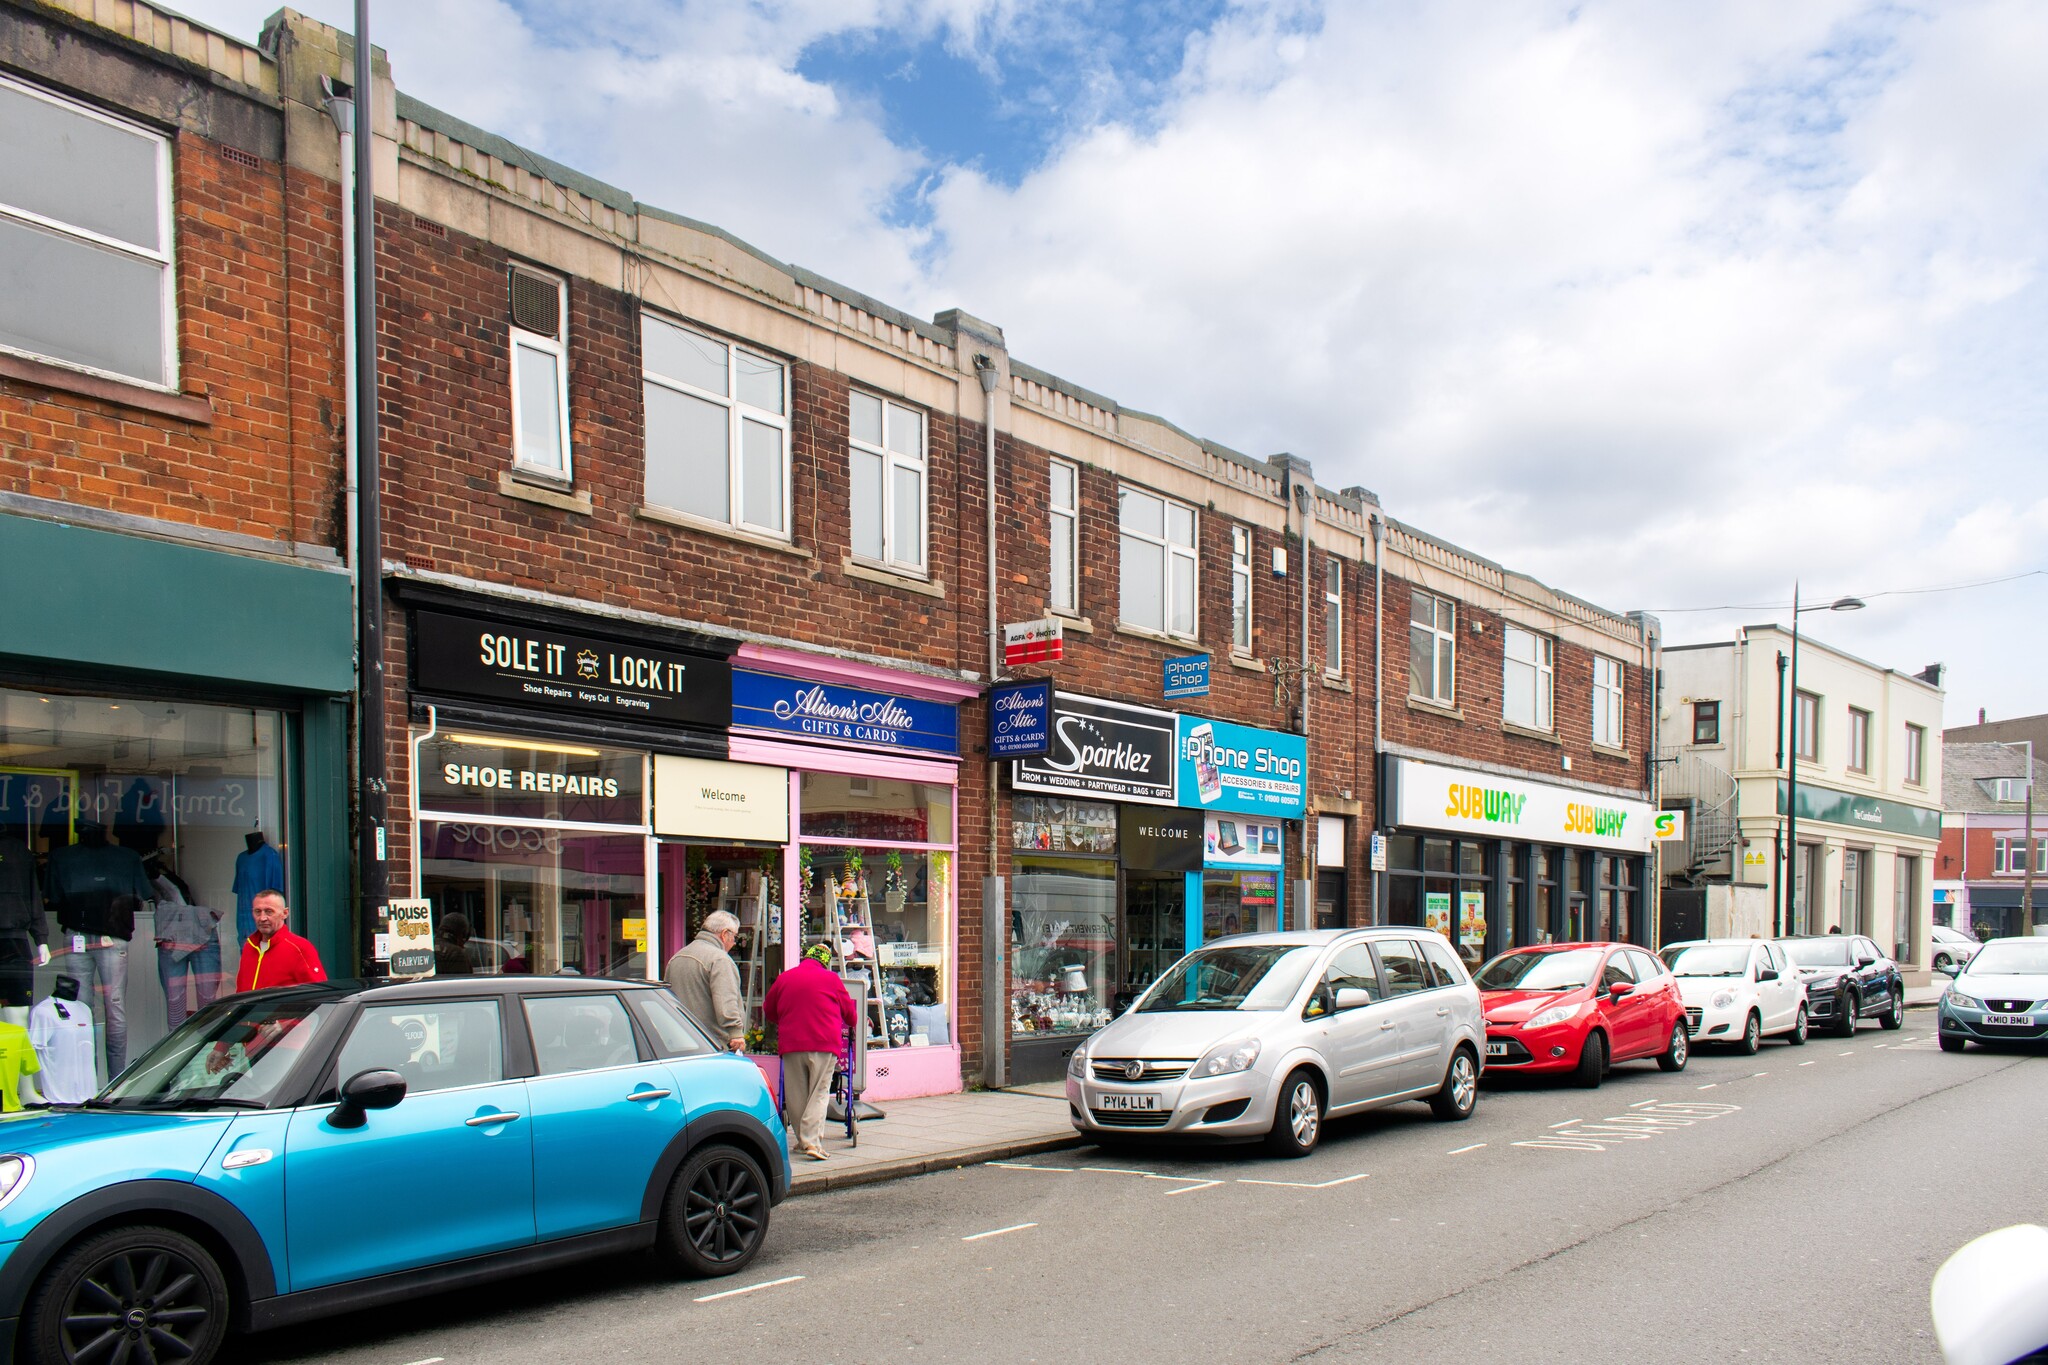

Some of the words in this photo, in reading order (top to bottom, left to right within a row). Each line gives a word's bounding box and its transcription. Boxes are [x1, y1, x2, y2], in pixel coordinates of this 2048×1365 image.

[1010, 633, 1026, 642] AGFA
[1036, 629, 1056, 639] PHOTO
[480, 633, 540, 673] SOLE
[609, 653, 663, 691] LOCK
[1168, 661, 1208, 674] Phone
[1170, 674, 1203, 687] Shop
[523, 683, 543, 694] Shoe
[544, 687, 573, 698] Repairs
[579, 691, 597, 702] Keys
[598, 693, 610, 703] Cut
[616, 696, 651, 710] Engraving
[774, 685, 858, 720] Alison's
[859, 697, 914, 729] Attic
[995, 690, 1044, 711] Alison's
[802, 719, 840, 735] GIFTS
[843, 725, 852, 736] &
[855, 726, 897, 743] CARDS
[997, 709, 1037, 734] Attic
[994, 733, 1014, 744] GIFTS
[1020, 732, 1045, 742] CARDS
[1043, 716, 1152, 773] Sparklez
[1186, 736, 1249, 770] Phone
[1254, 747, 1301, 781] Shop
[444, 763, 514, 790] SHOE
[520, 770, 619, 798] REPAIRS
[1021, 772, 1041, 783] PROM
[1049, 776, 1080, 788] WEDDING
[1087, 781, 1126, 793] PARTYWEAR
[1132, 786, 1149, 796] BAGS
[1155, 789, 1172, 798] GIFTS
[1222, 775, 1267, 789] ACCESSORIES
[1274, 782, 1299, 793] REPAIRS
[701, 786, 746, 803] Welcome
[1445, 783, 1527, 824] SUBWAY
[1564, 802, 1628, 838] SUBWAY
[1139, 826, 1188, 839] WELCOME
[388, 904, 429, 921] House
[397, 919, 431, 940] Signs
[398, 955, 430, 967] FAIRVIEW
[1987, 1014, 2008, 1025] KM10
[2010, 1015, 2029, 1025] BMU
[1103, 1096, 1128, 1109] PY14
[1130, 1096, 1154, 1109] LLW
[1510, 1102, 1742, 1151] DISABLED
